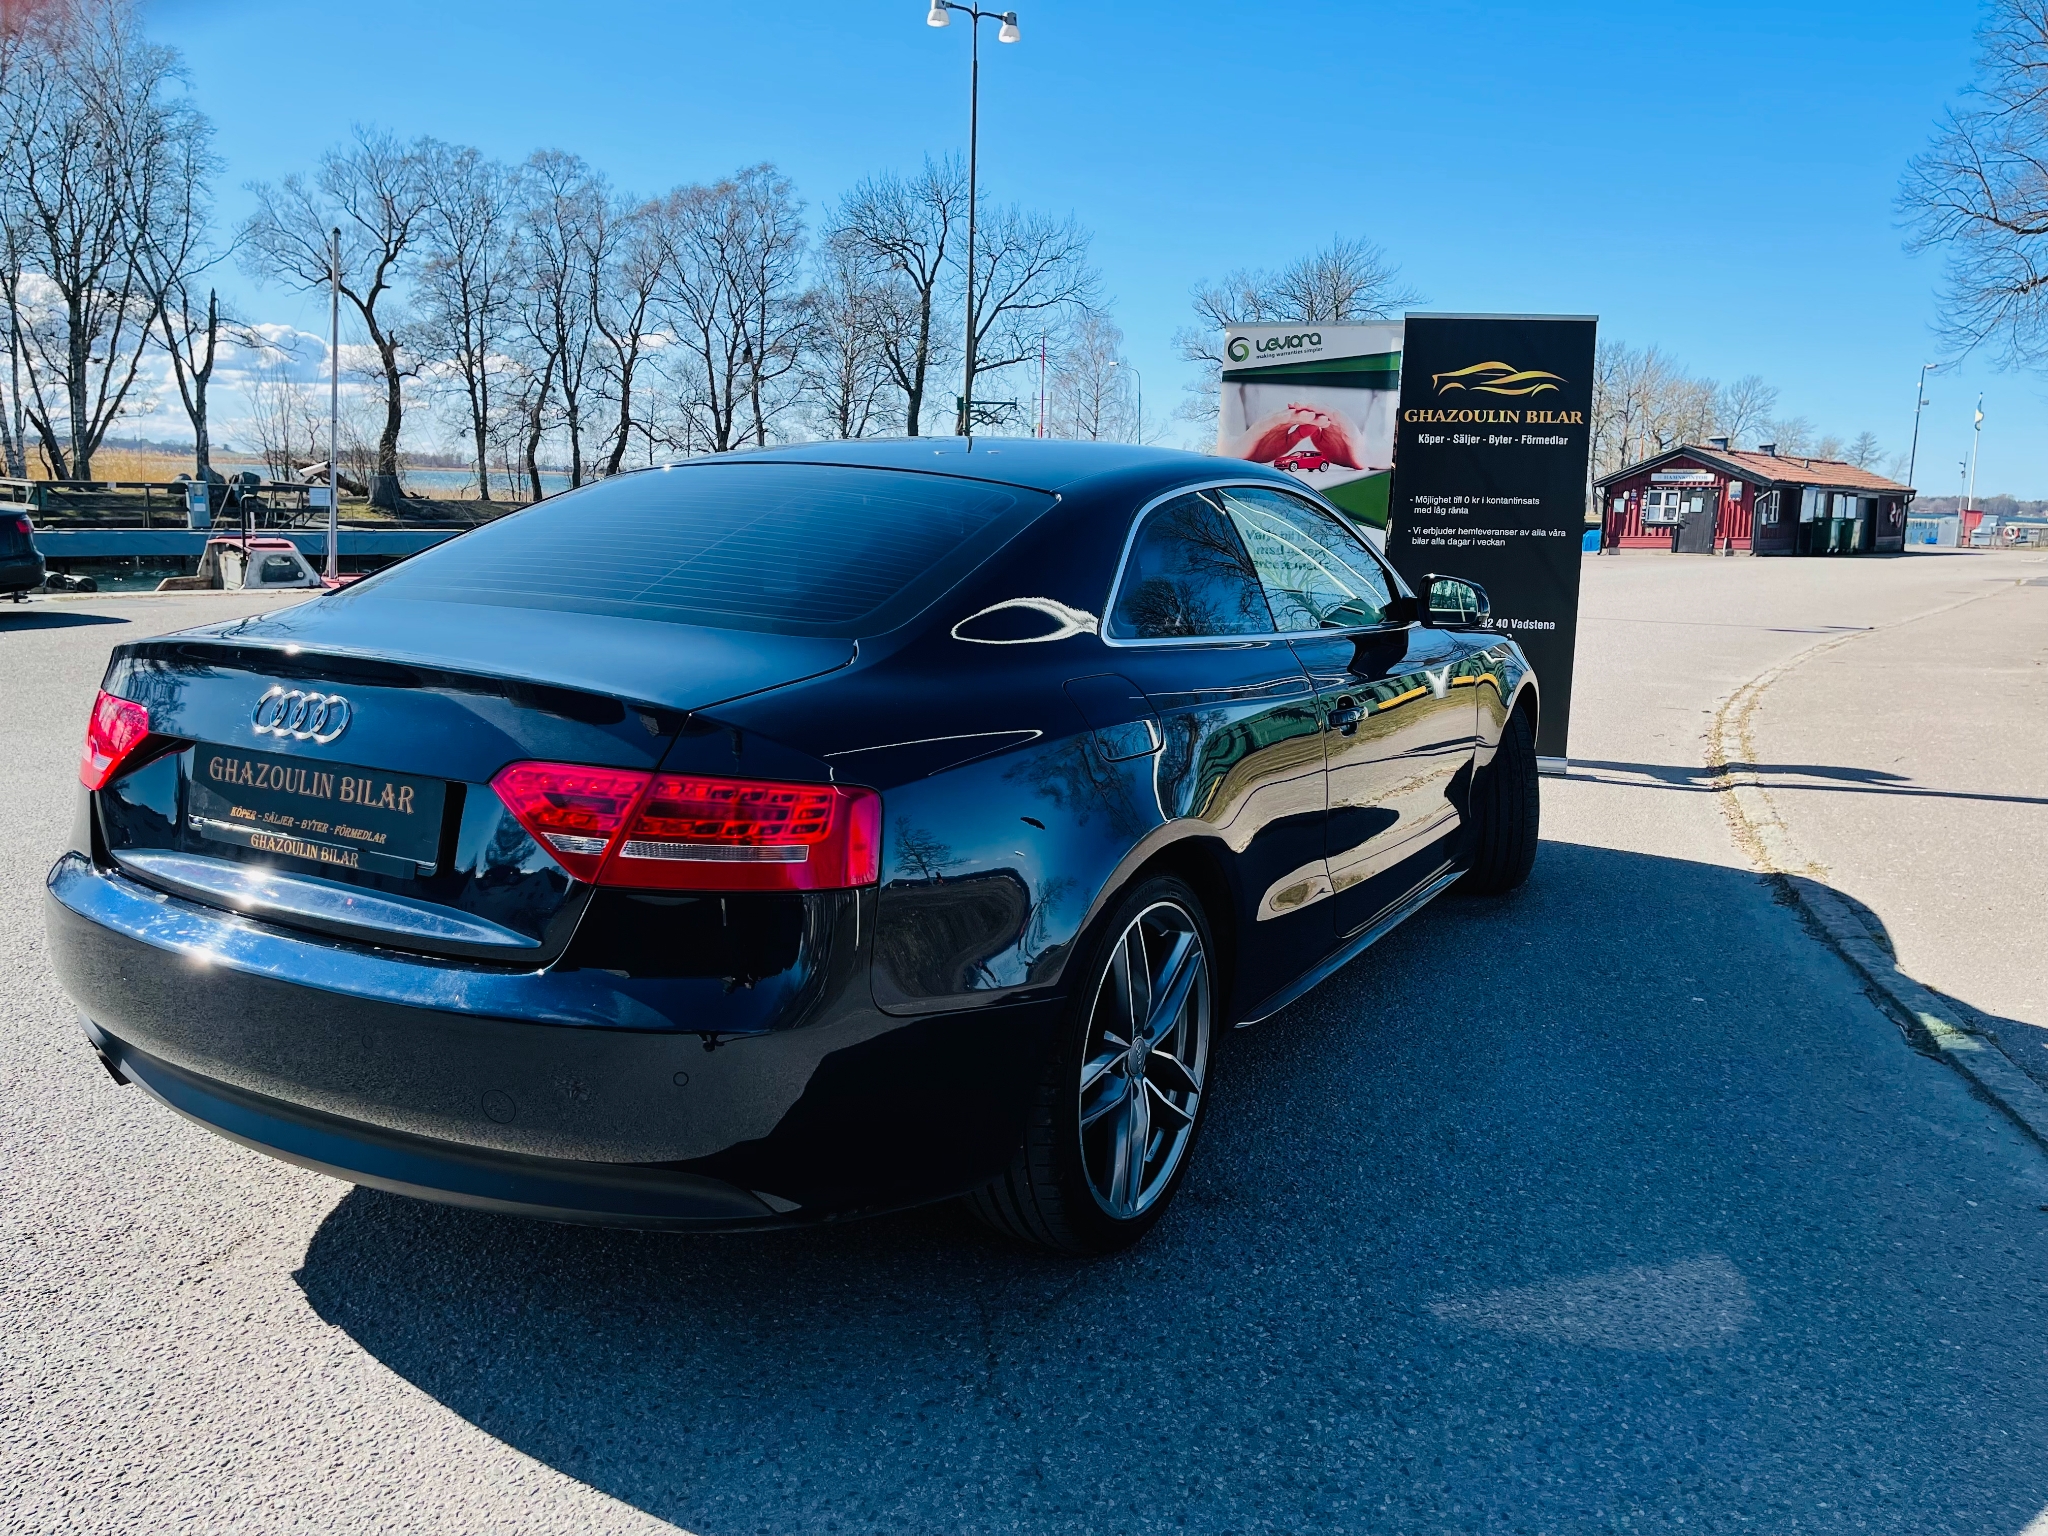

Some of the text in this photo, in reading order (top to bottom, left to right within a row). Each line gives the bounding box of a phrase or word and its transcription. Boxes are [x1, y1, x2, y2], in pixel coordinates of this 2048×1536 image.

[1404, 409, 1583, 424] GHAZOULIN BILAR
[1418, 433, 1445, 445] Köper
[1453, 434, 1480, 445] Säljer
[1489, 435, 1512, 445] Byter
[1521, 435, 1568, 445] Förmedlar
[1415, 496, 1451, 505] Möjlighet
[1453, 496, 1462, 504] till
[1464, 496, 1470, 504] 0
[1471, 496, 1481, 504] kr
[1486, 496, 1540, 505] kontantinsats
[1414, 506, 1469, 516] med låg ränta
[1412, 526, 1421, 534] Vi
[1422, 526, 1456, 536] erbjuder
[1457, 527, 1518, 536] hemleveranser
[1531, 528, 1547, 536] alla
[1548, 528, 1567, 537] våra
[1411, 536, 1430, 545] bilar
[1431, 537, 1445, 545] alla
[1447, 538, 1471, 547] dagar
[1477, 538, 1506, 546] veckan
[1496, 618, 1508, 629] 40
[1511, 619, 1556, 630] Vadstena
[209, 756, 415, 815] GHAZOULIN BILAR
[230, 806, 257, 820] KÖPER
[263, 811, 294, 827] SÄLJER
[301, 819, 329, 833] BYTER
[334, 824, 387, 844] FÖRMEDLAR
[251, 833, 359, 868] GHAZOULIN BILAR
